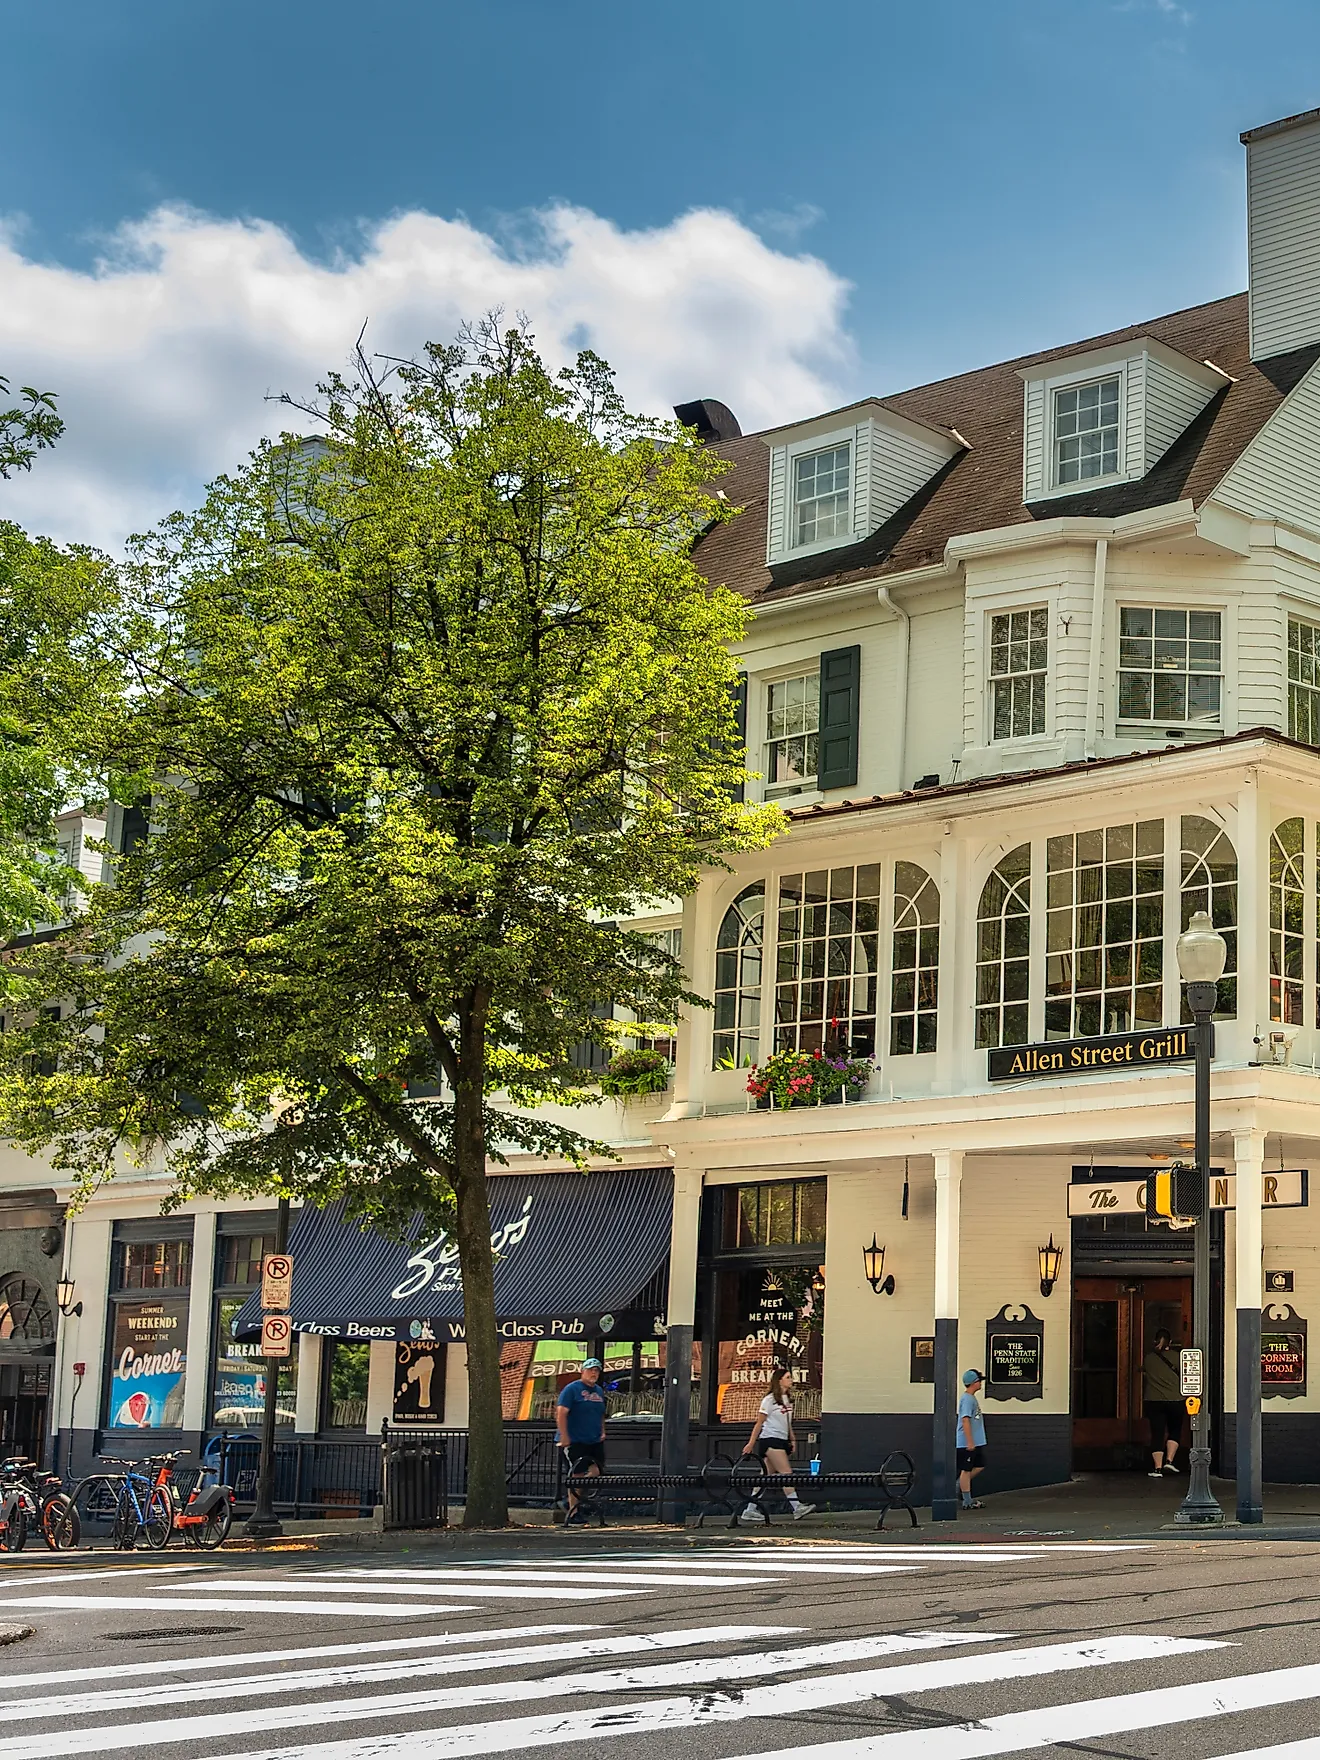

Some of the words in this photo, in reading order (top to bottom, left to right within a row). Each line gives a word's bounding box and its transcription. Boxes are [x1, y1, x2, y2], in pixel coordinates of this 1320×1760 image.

[1009, 1051, 1064, 1074] Allen
[1070, 1041, 1133, 1067] Street
[1140, 1032, 1187, 1059] Grill
[1088, 1188, 1119, 1209] The
[1136, 1176, 1278, 1210] CNR
[431, 1281, 456, 1292] Since
[760, 1298, 783, 1308] MEET
[749, 1313, 761, 1321] ME
[776, 1312, 794, 1320] THE
[128, 1317, 178, 1329] WEEKENDS
[551, 1318, 584, 1335] Pub
[346, 1322, 396, 1337] Beers
[737, 1328, 805, 1358] CORNER!
[1268, 1343, 1289, 1352] THE
[228, 1345, 263, 1357] BREAK
[119, 1346, 181, 1381] Corner
[761, 1356, 780, 1365] FOR
[1260, 1353, 1298, 1362] CORNER
[1265, 1364, 1293, 1373] ROOM
[731, 1369, 809, 1383] BREAKST
